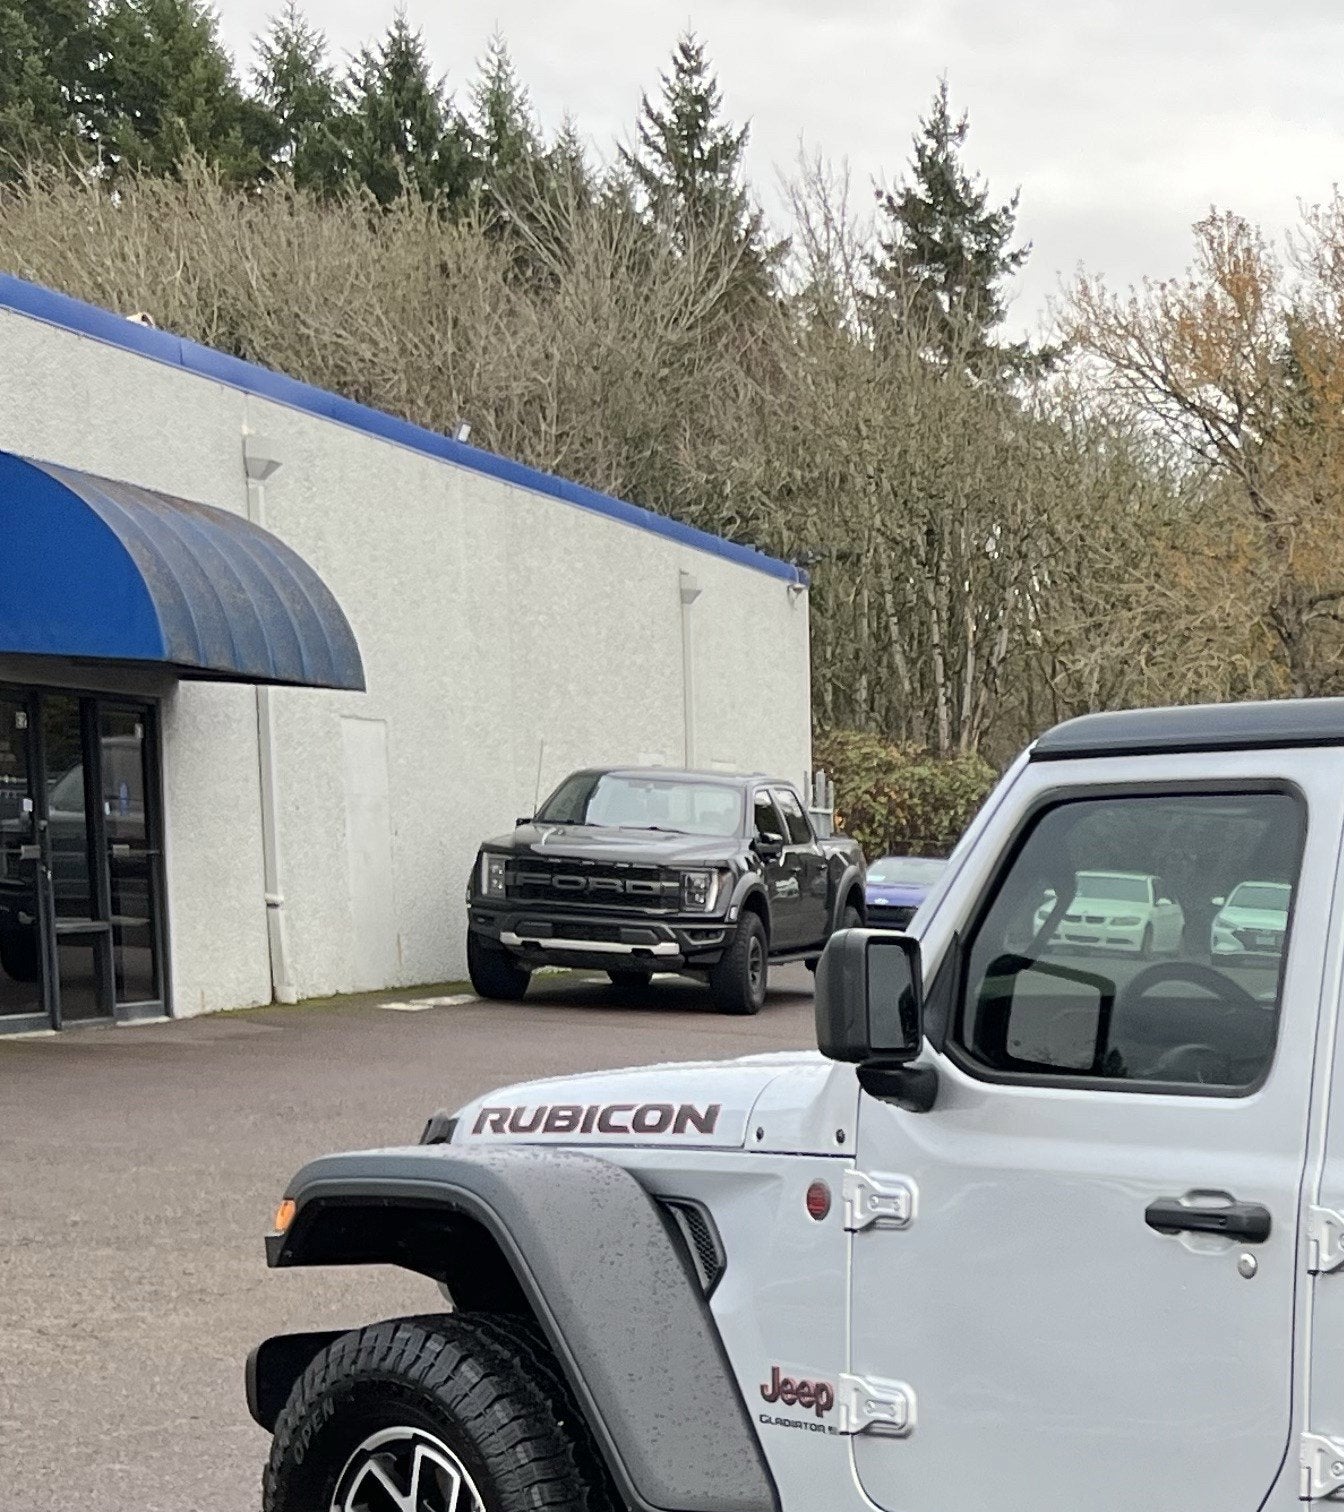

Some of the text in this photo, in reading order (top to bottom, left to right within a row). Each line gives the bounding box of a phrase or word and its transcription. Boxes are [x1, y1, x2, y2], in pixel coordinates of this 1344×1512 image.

[513, 872, 661, 895] FORD
[471, 1103, 722, 1135] RUBICON
[760, 1365, 835, 1418] Jeep
[759, 1414, 826, 1434] GLADIATOR
